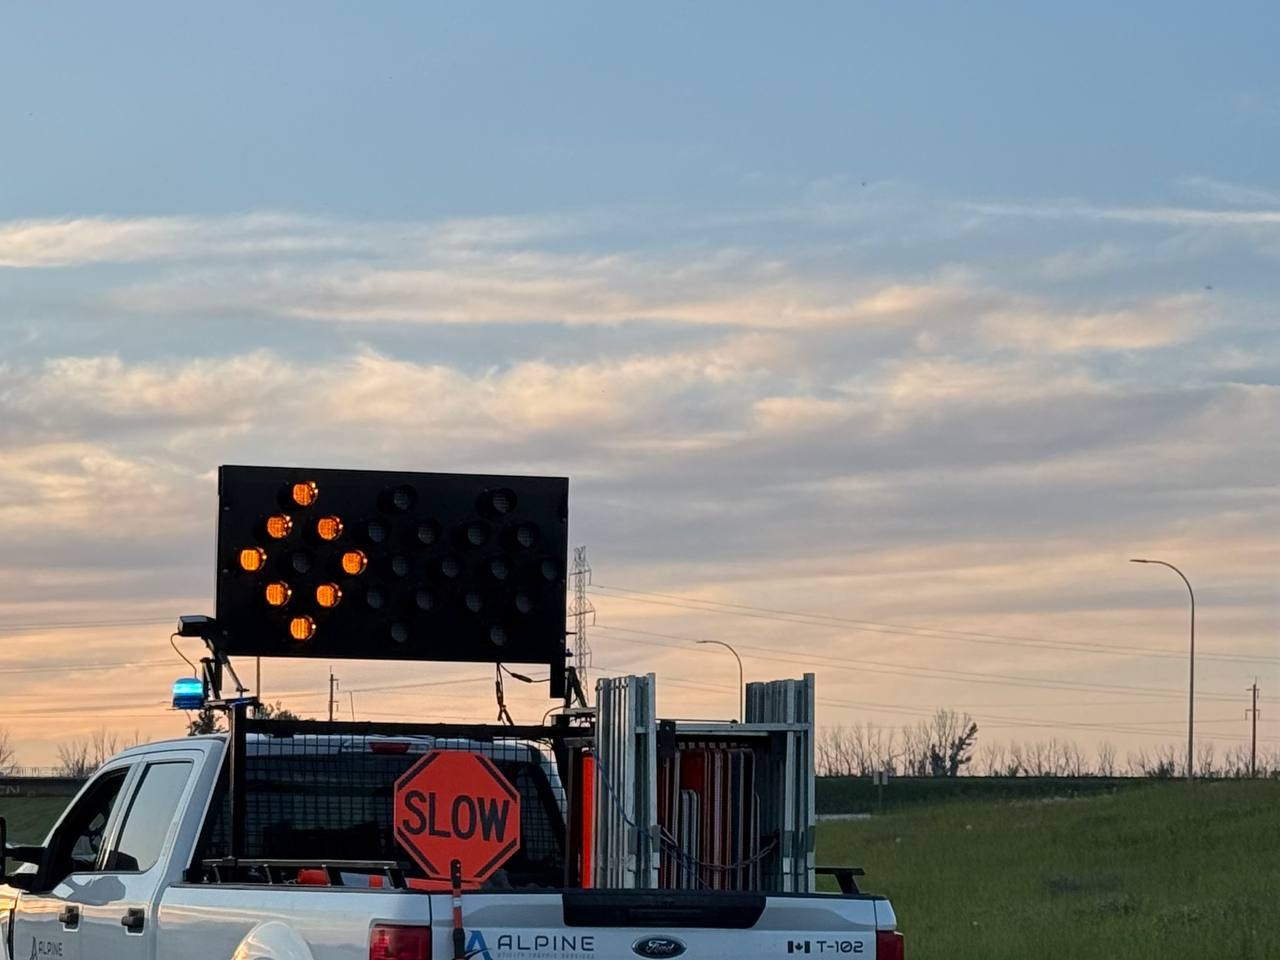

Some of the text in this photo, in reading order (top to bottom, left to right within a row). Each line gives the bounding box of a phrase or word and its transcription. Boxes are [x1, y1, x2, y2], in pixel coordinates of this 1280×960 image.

[402, 790, 510, 843] SLOW
[38, 941, 63, 957] ALPINE
[497, 935, 595, 951] ALPINE
[816, 940, 864, 953] T-102
